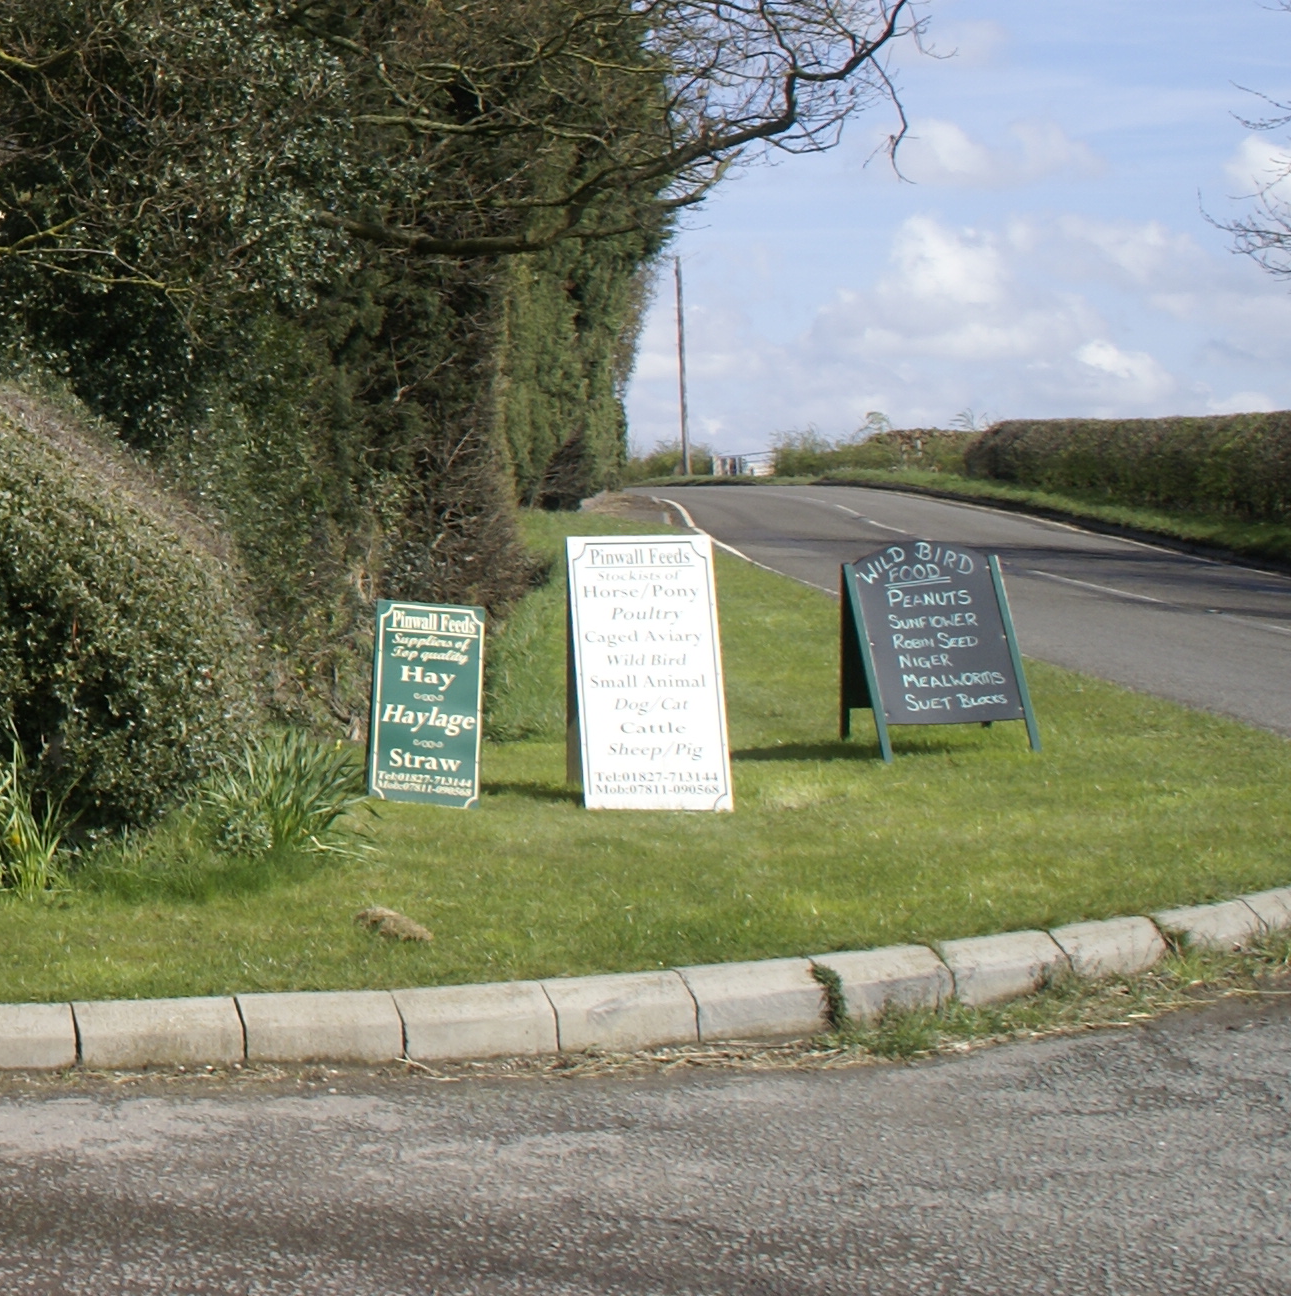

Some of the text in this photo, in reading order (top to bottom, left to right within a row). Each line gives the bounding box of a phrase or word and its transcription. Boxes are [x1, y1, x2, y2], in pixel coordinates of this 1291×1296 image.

[590, 547, 691, 565] Pinwall Feeds
[859, 541, 975, 585] WILD BIRD
[597, 570, 682, 581] Stockists of
[888, 563, 941, 583] FOOD
[583, 583, 699, 603] Horse/Pony
[886, 589, 972, 608] PEANUTS
[392, 610, 477, 634] Pinwall Feeds
[611, 606, 683, 625] Poultry
[888, 612, 979, 630] SUNFLOWER
[392, 632, 472, 652] Suppliers of
[584, 630, 702, 647] Caged Aviary
[936, 631, 979, 649] SEED
[391, 645, 469, 665] Top quality
[607, 653, 687, 667] Wild Bird
[898, 653, 954, 669] NIGER
[400, 665, 456, 692] Hay
[590, 674, 707, 688] Small Animal
[614, 695, 688, 715] Dog/Cat
[904, 693, 953, 712] SUET
[381, 703, 476, 736] Haylage
[620, 721, 687, 734] Cattle
[389, 748, 462, 772] Straw
[608, 741, 704, 761] Sheep/Pig
[594, 771, 718, 783] Tel:01827-713144
[594, 784, 720, 795] Mob:07811-090568
